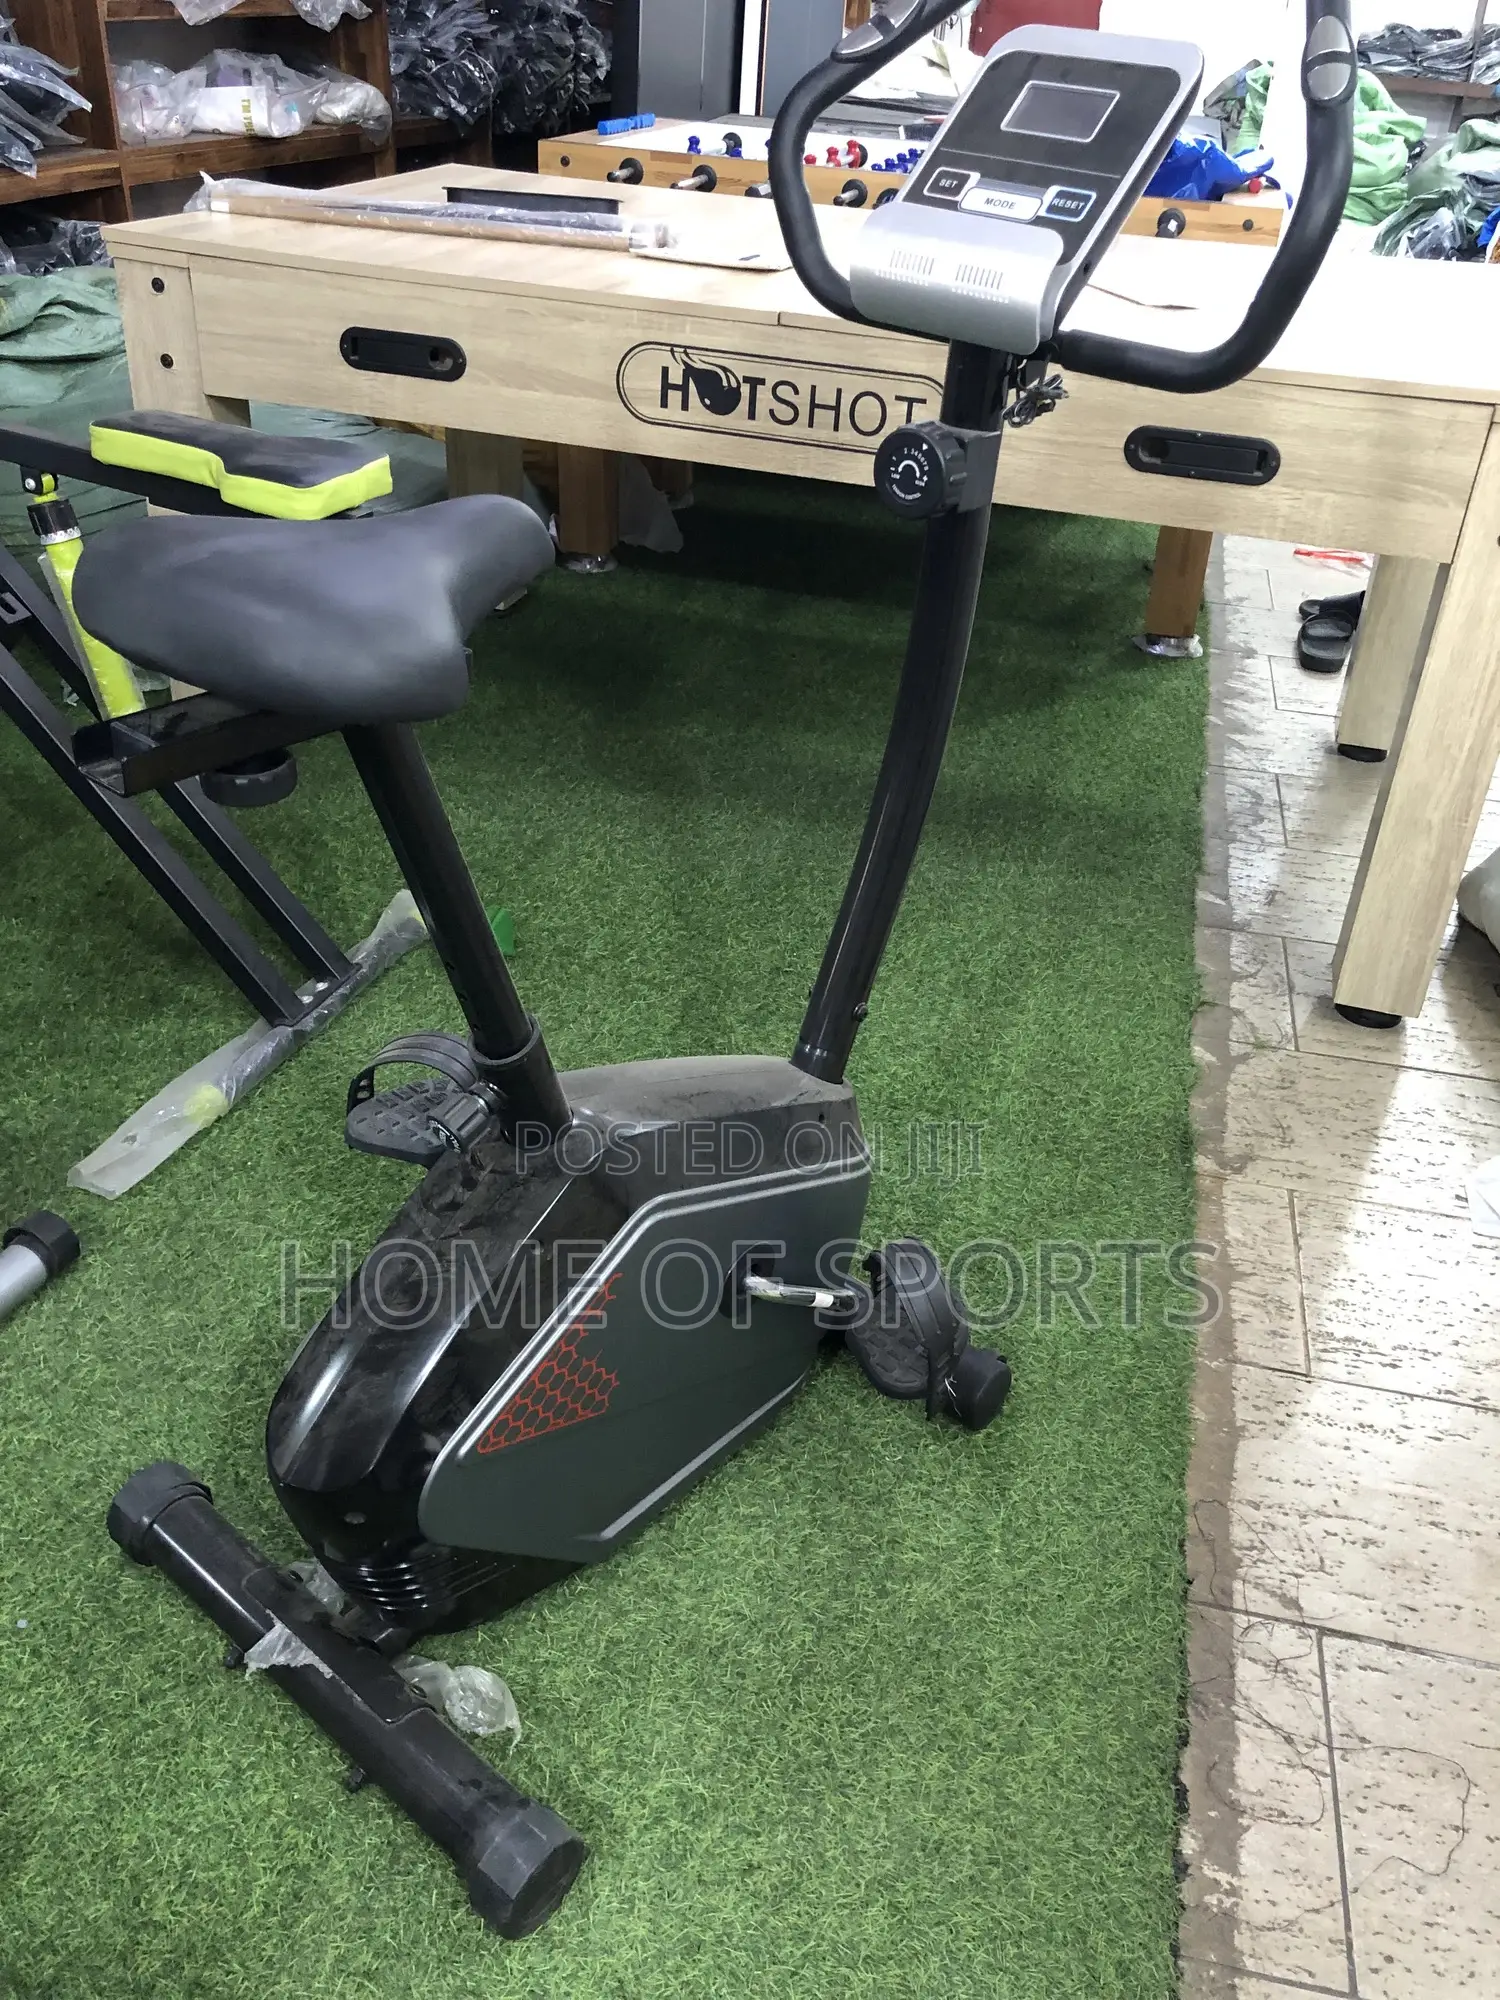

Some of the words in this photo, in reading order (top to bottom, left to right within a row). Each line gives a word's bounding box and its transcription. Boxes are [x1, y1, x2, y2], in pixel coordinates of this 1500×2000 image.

[939, 178, 958, 189] SET
[984, 197, 1016, 210] MODE
[1052, 197, 1085, 211] RESET
